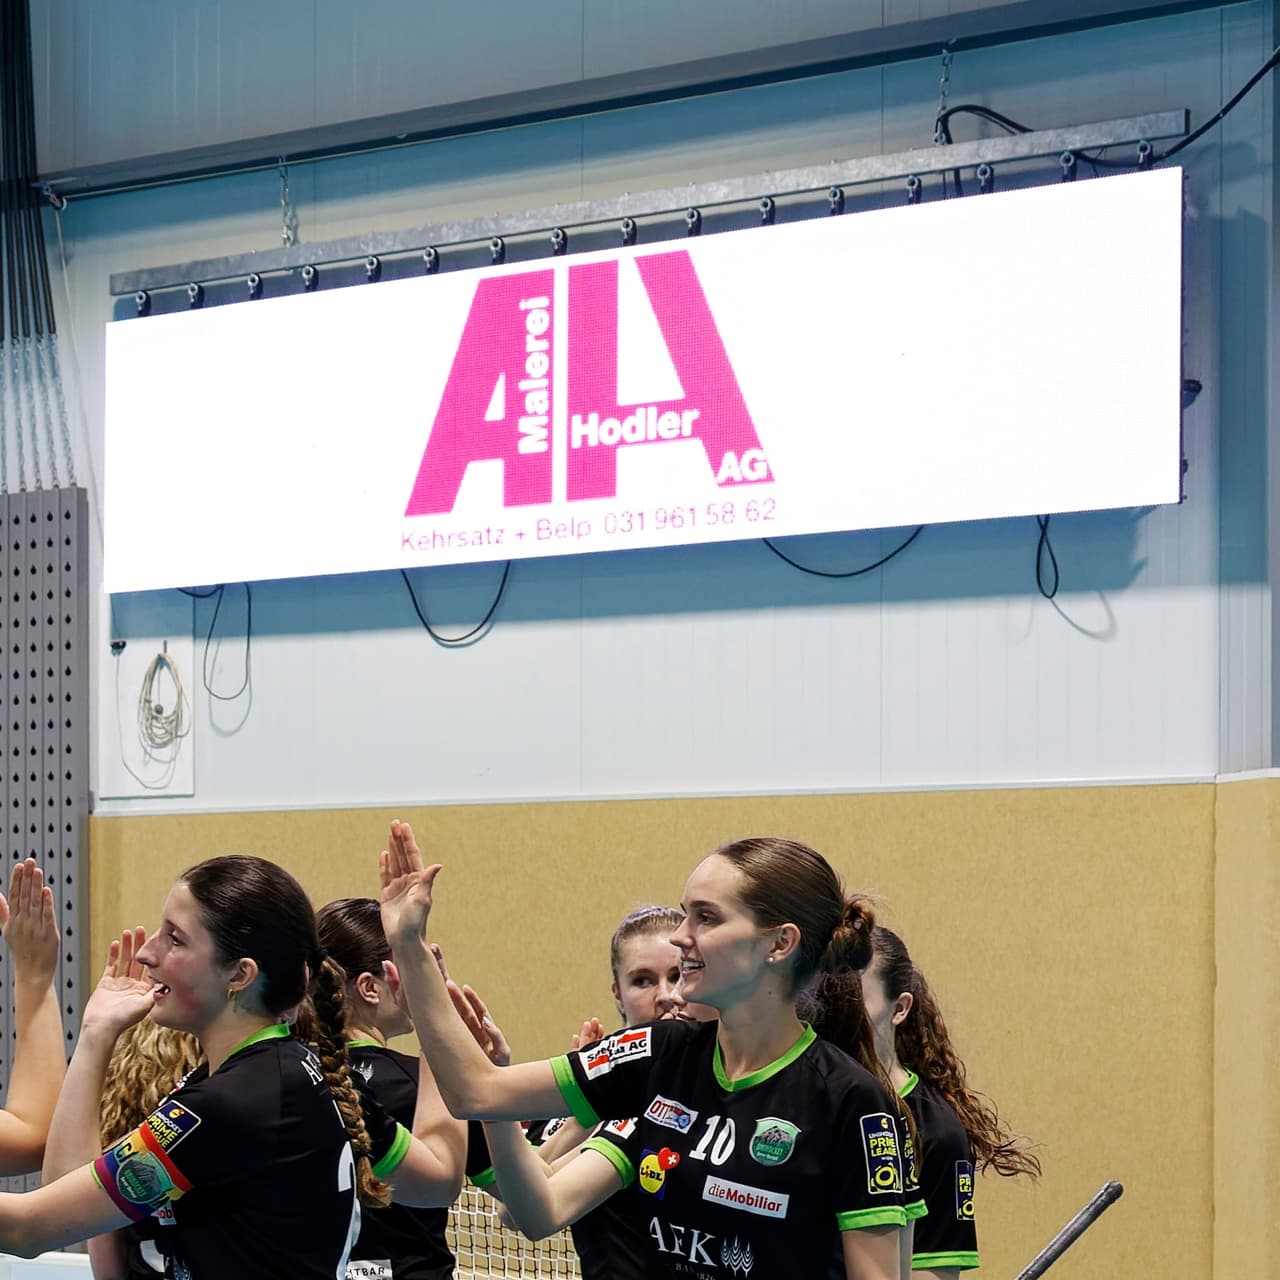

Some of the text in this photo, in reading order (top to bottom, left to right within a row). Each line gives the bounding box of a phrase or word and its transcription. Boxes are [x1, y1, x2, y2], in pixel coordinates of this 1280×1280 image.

[518, 296, 551, 454] Malerei
[571, 406, 700, 449] Hodler
[716, 448, 769, 485] AG
[401, 525, 505, 552] Kehrsatz
[536, 517, 592, 540] Belp
[148, 1115, 178, 1142] PRIME
[689, 1115, 736, 1166] 10
